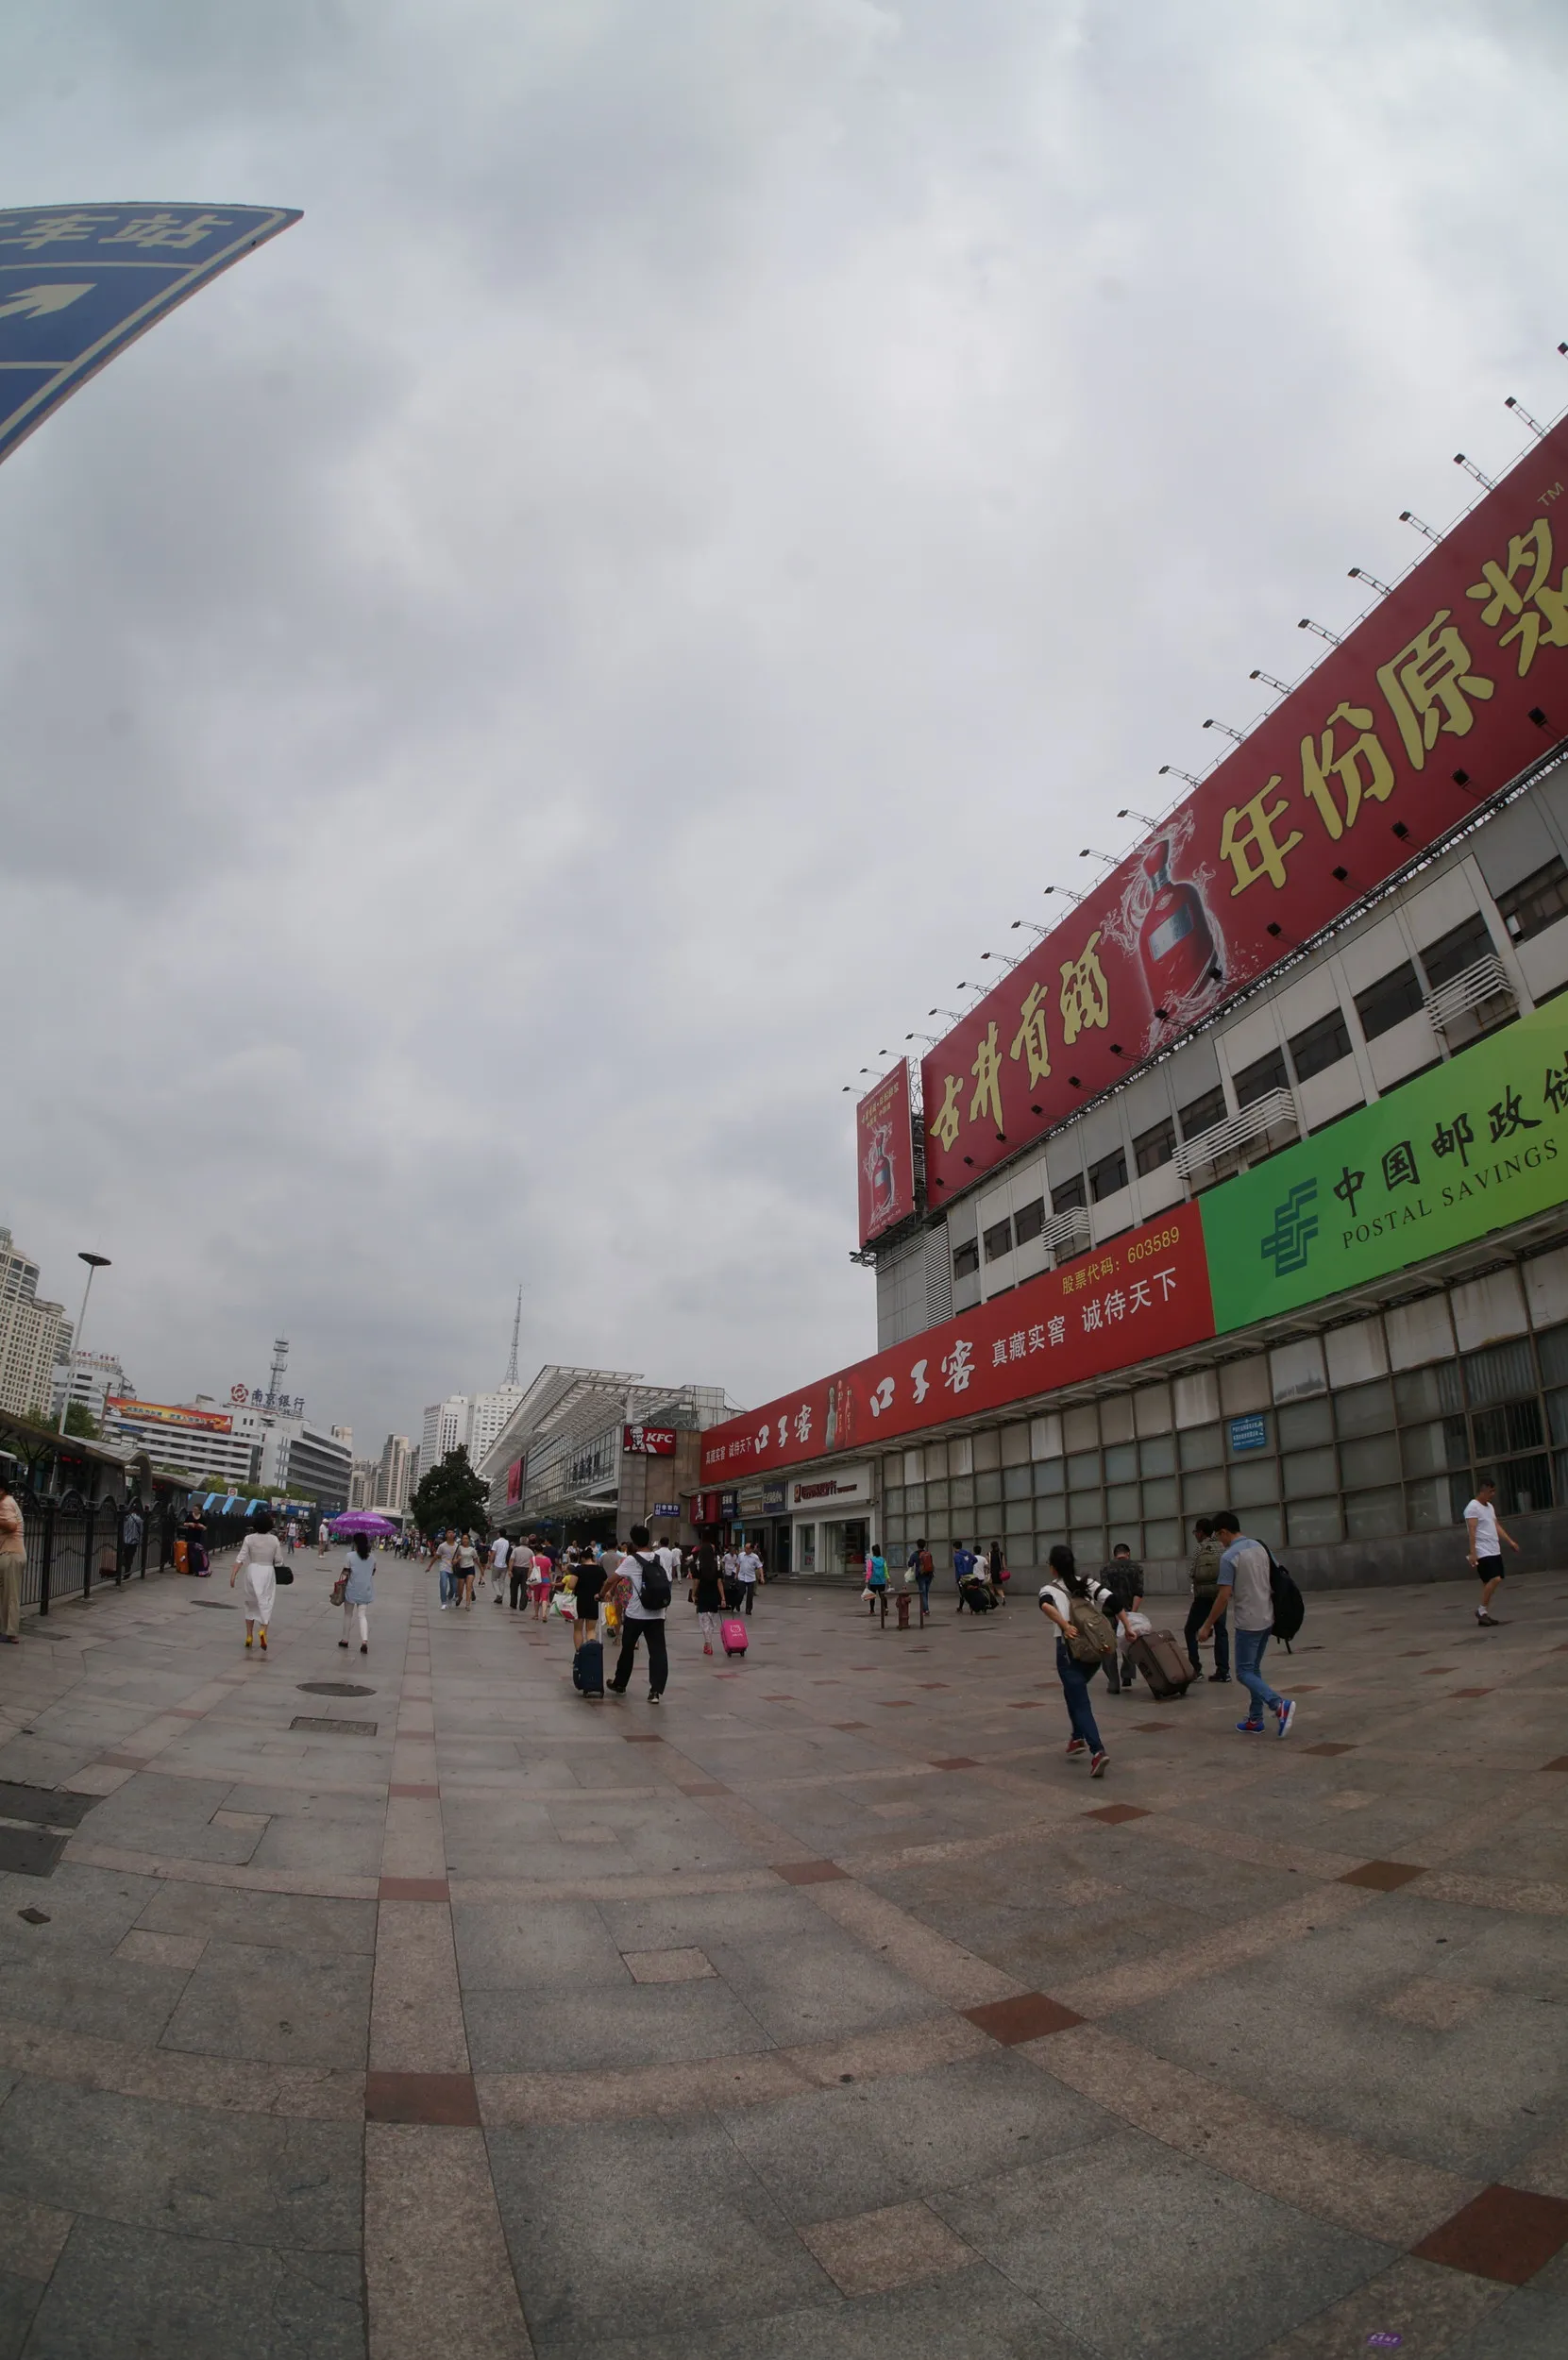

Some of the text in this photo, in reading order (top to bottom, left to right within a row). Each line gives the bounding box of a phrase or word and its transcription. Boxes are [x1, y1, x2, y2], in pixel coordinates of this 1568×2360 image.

[0, 214, 234, 250] 车站
[1220, 518, 1568, 897] 年份原浆
[1341, 1138, 1558, 1250] POSTAL SAVINGS
[1127, 1225, 1180, 1264] 603589
[869, 1266, 1177, 1418] 口子窖 真藏实窖 诚待天下
[252, 1388, 305, 1411] 南京银行
[646, 1432, 674, 1443] KFC
[754, 1404, 813, 1455] 口子窖
